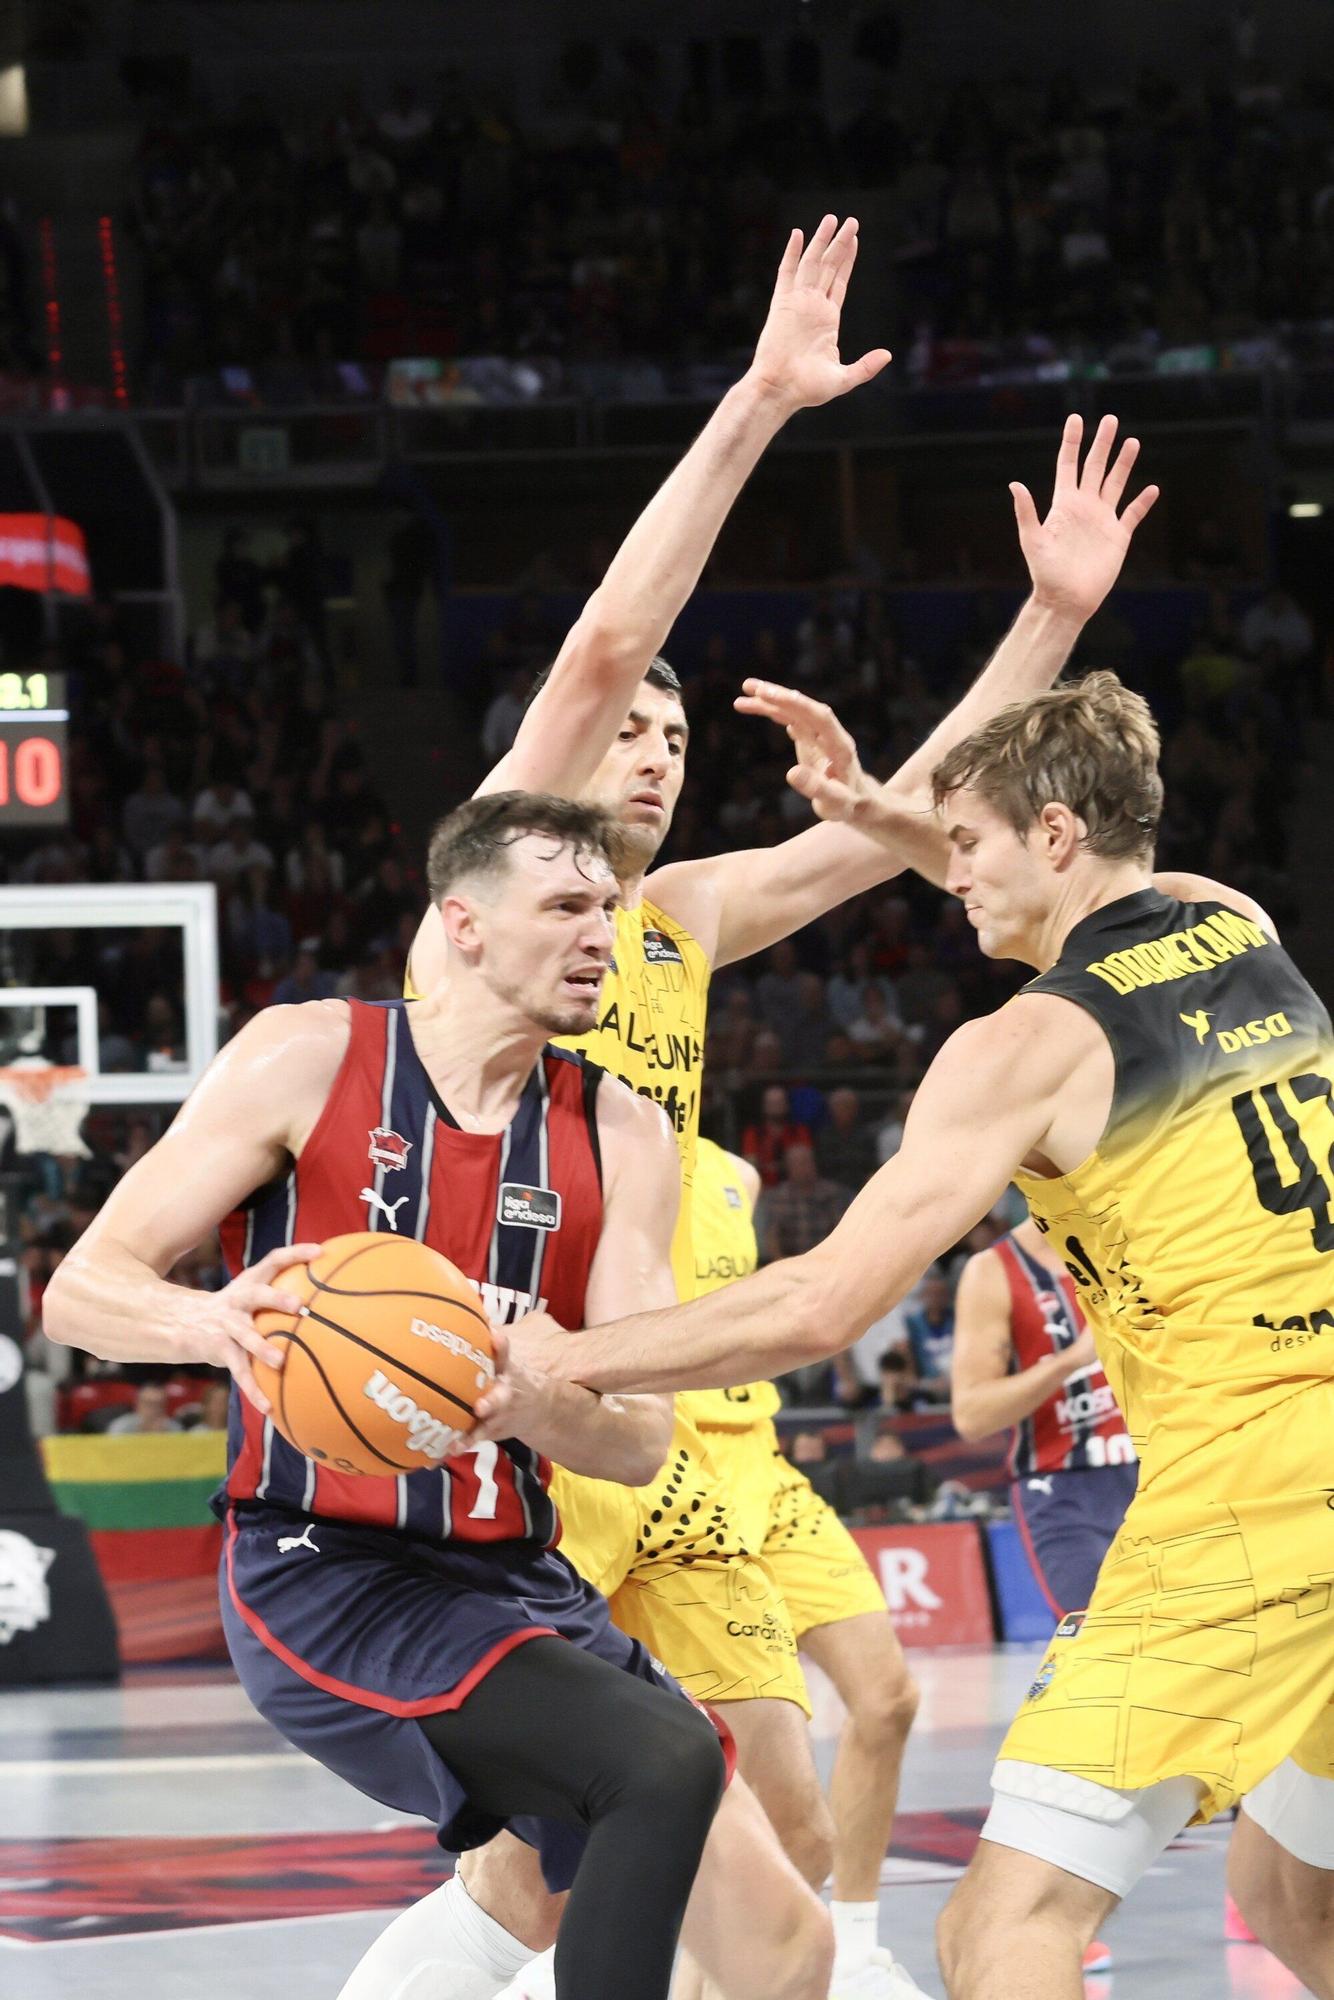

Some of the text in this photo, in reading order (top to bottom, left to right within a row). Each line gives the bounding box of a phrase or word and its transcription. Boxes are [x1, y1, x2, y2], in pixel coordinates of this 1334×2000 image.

[1216, 1012, 1293, 1054] DISA
[504, 1196, 530, 1211] liga
[504, 1208, 556, 1225] endesa
